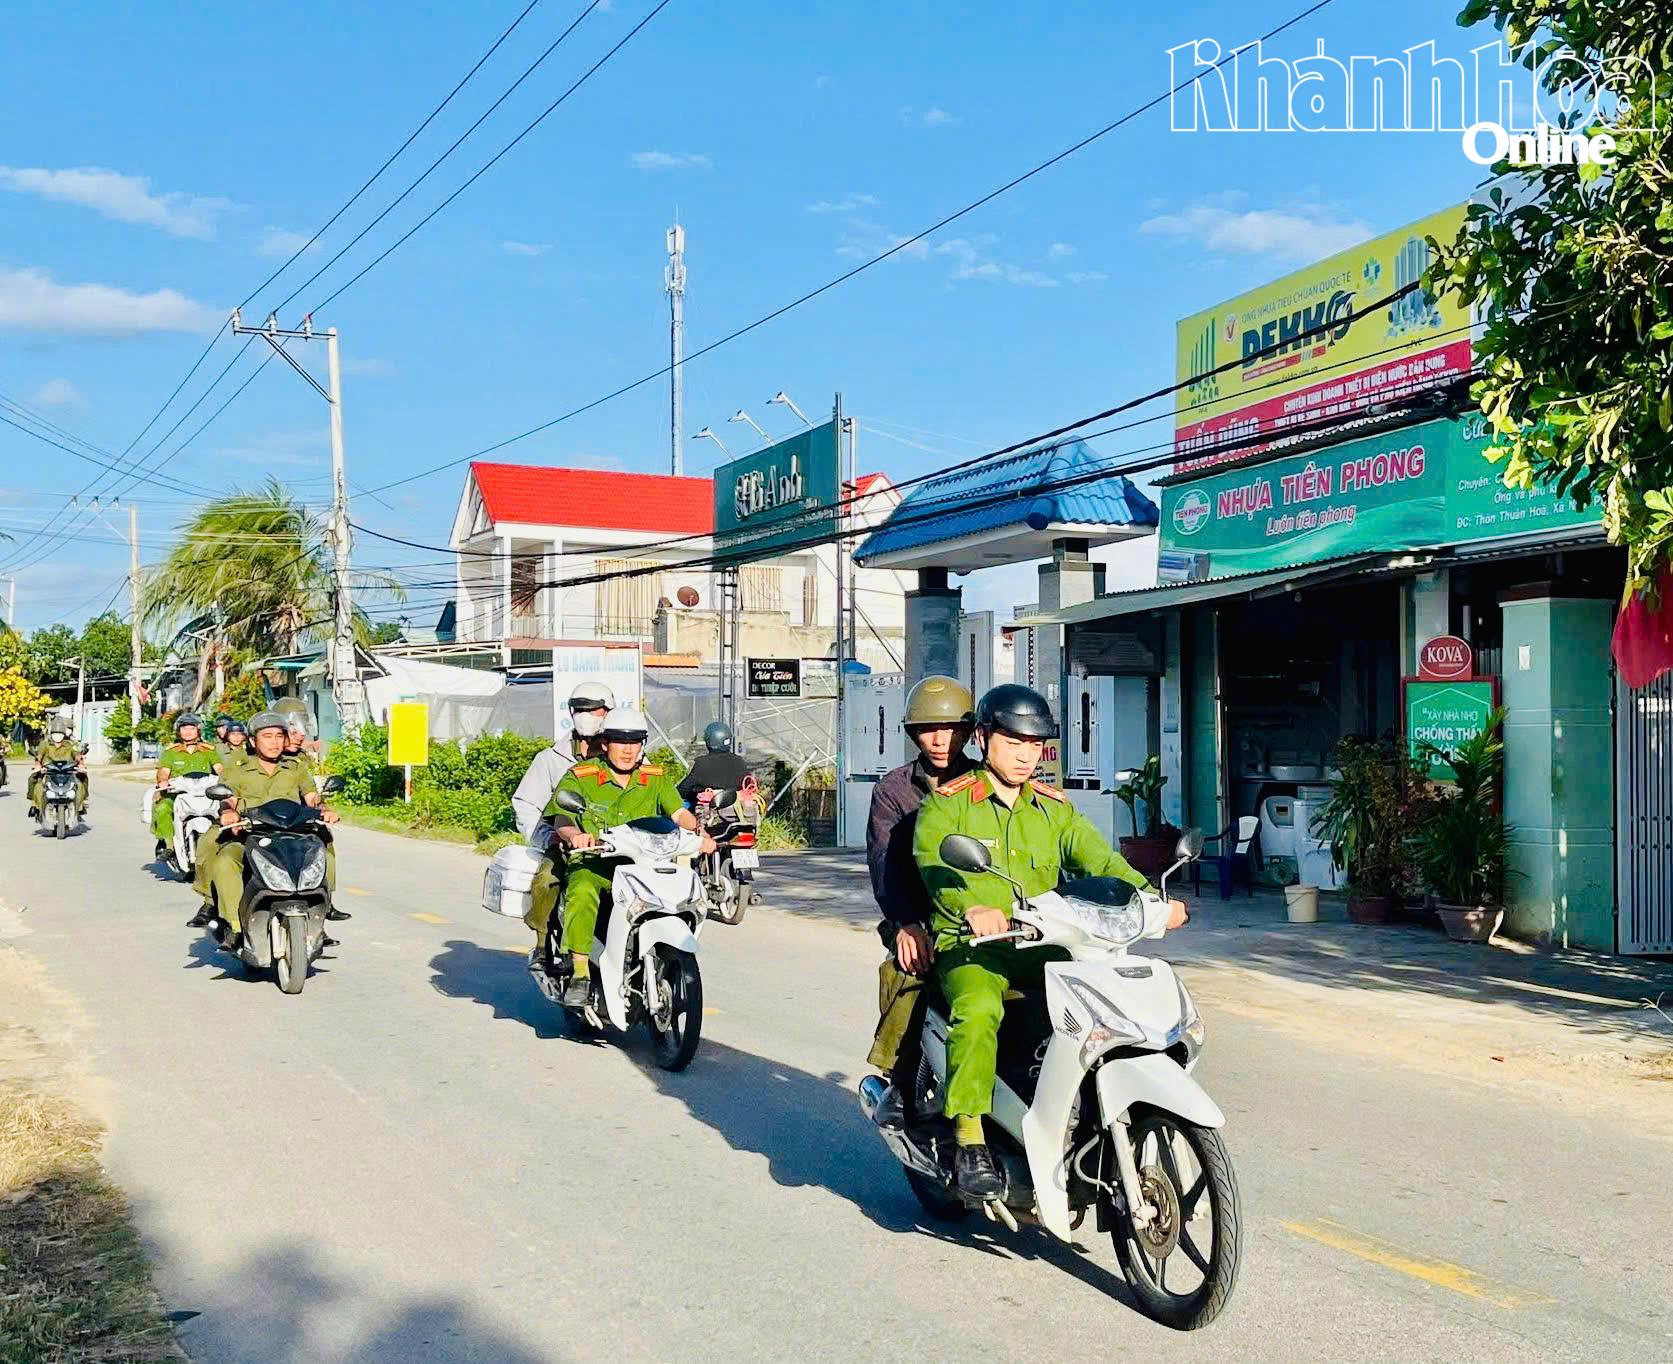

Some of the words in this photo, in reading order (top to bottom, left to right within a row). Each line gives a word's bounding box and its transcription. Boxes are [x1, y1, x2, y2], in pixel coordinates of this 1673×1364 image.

[1217, 477, 1273, 521] NHỰA
[1340, 445, 1425, 494] PHONG
[1427, 646, 1463, 663] KOVA
[752, 662, 776, 670] DECOR
[1415, 722, 1454, 741] CHỐNG
